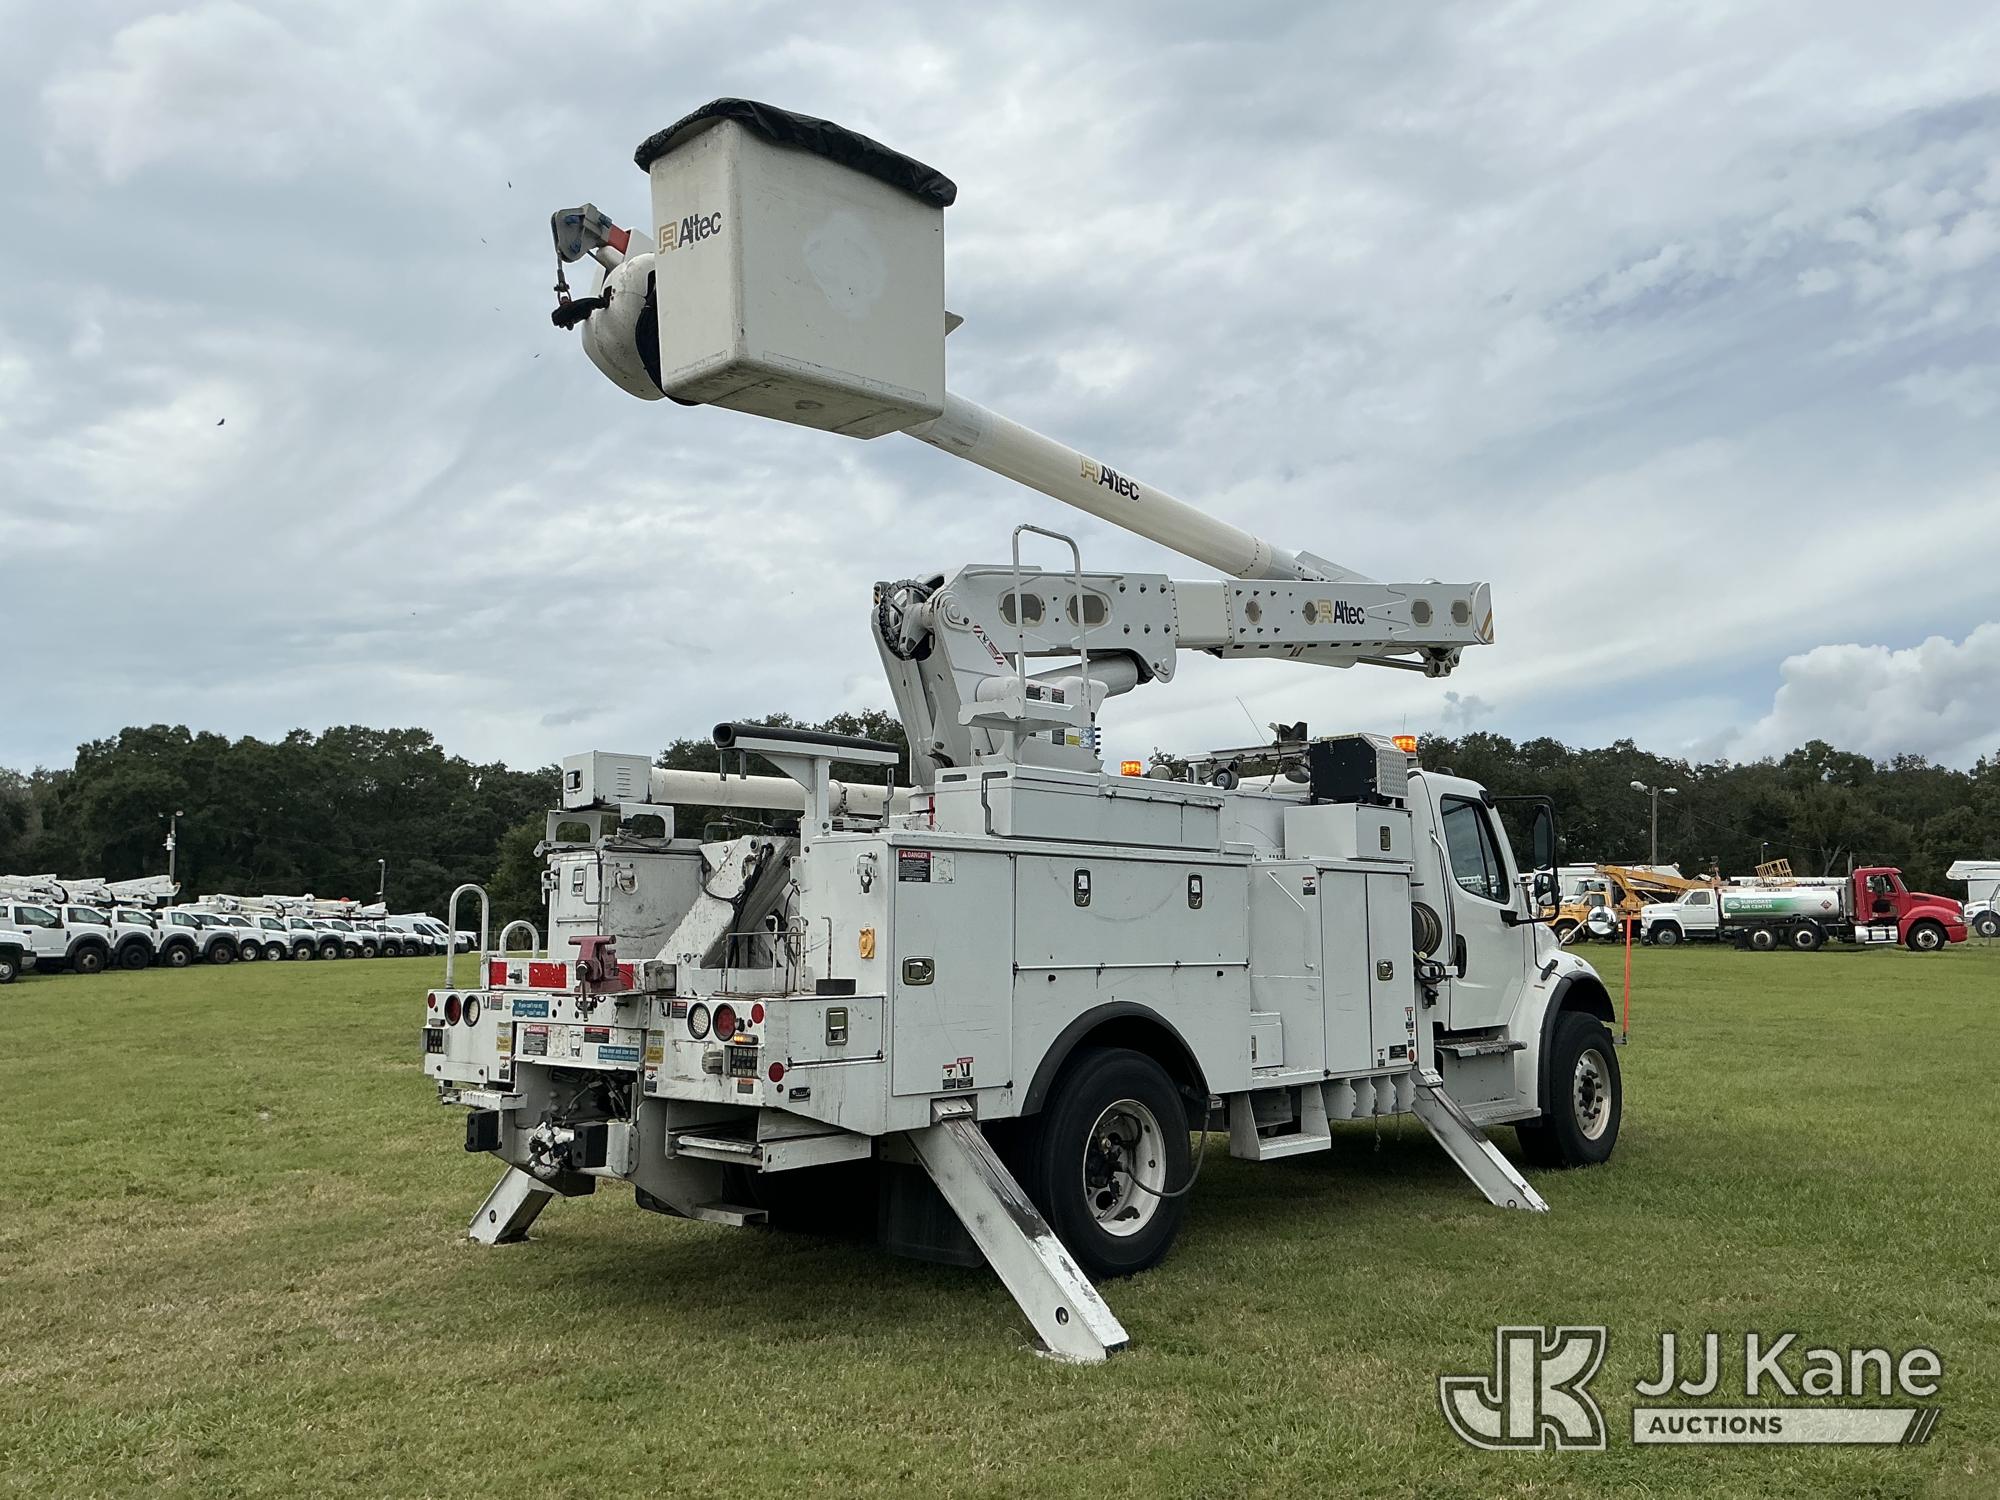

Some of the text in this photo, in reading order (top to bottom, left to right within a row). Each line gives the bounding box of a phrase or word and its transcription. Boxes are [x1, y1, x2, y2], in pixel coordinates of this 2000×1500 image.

[678, 211, 722, 248] Altec
[1098, 464, 1140, 501] Altec
[1333, 600, 1365, 625] Altec
[907, 851, 928, 859] DANGER
